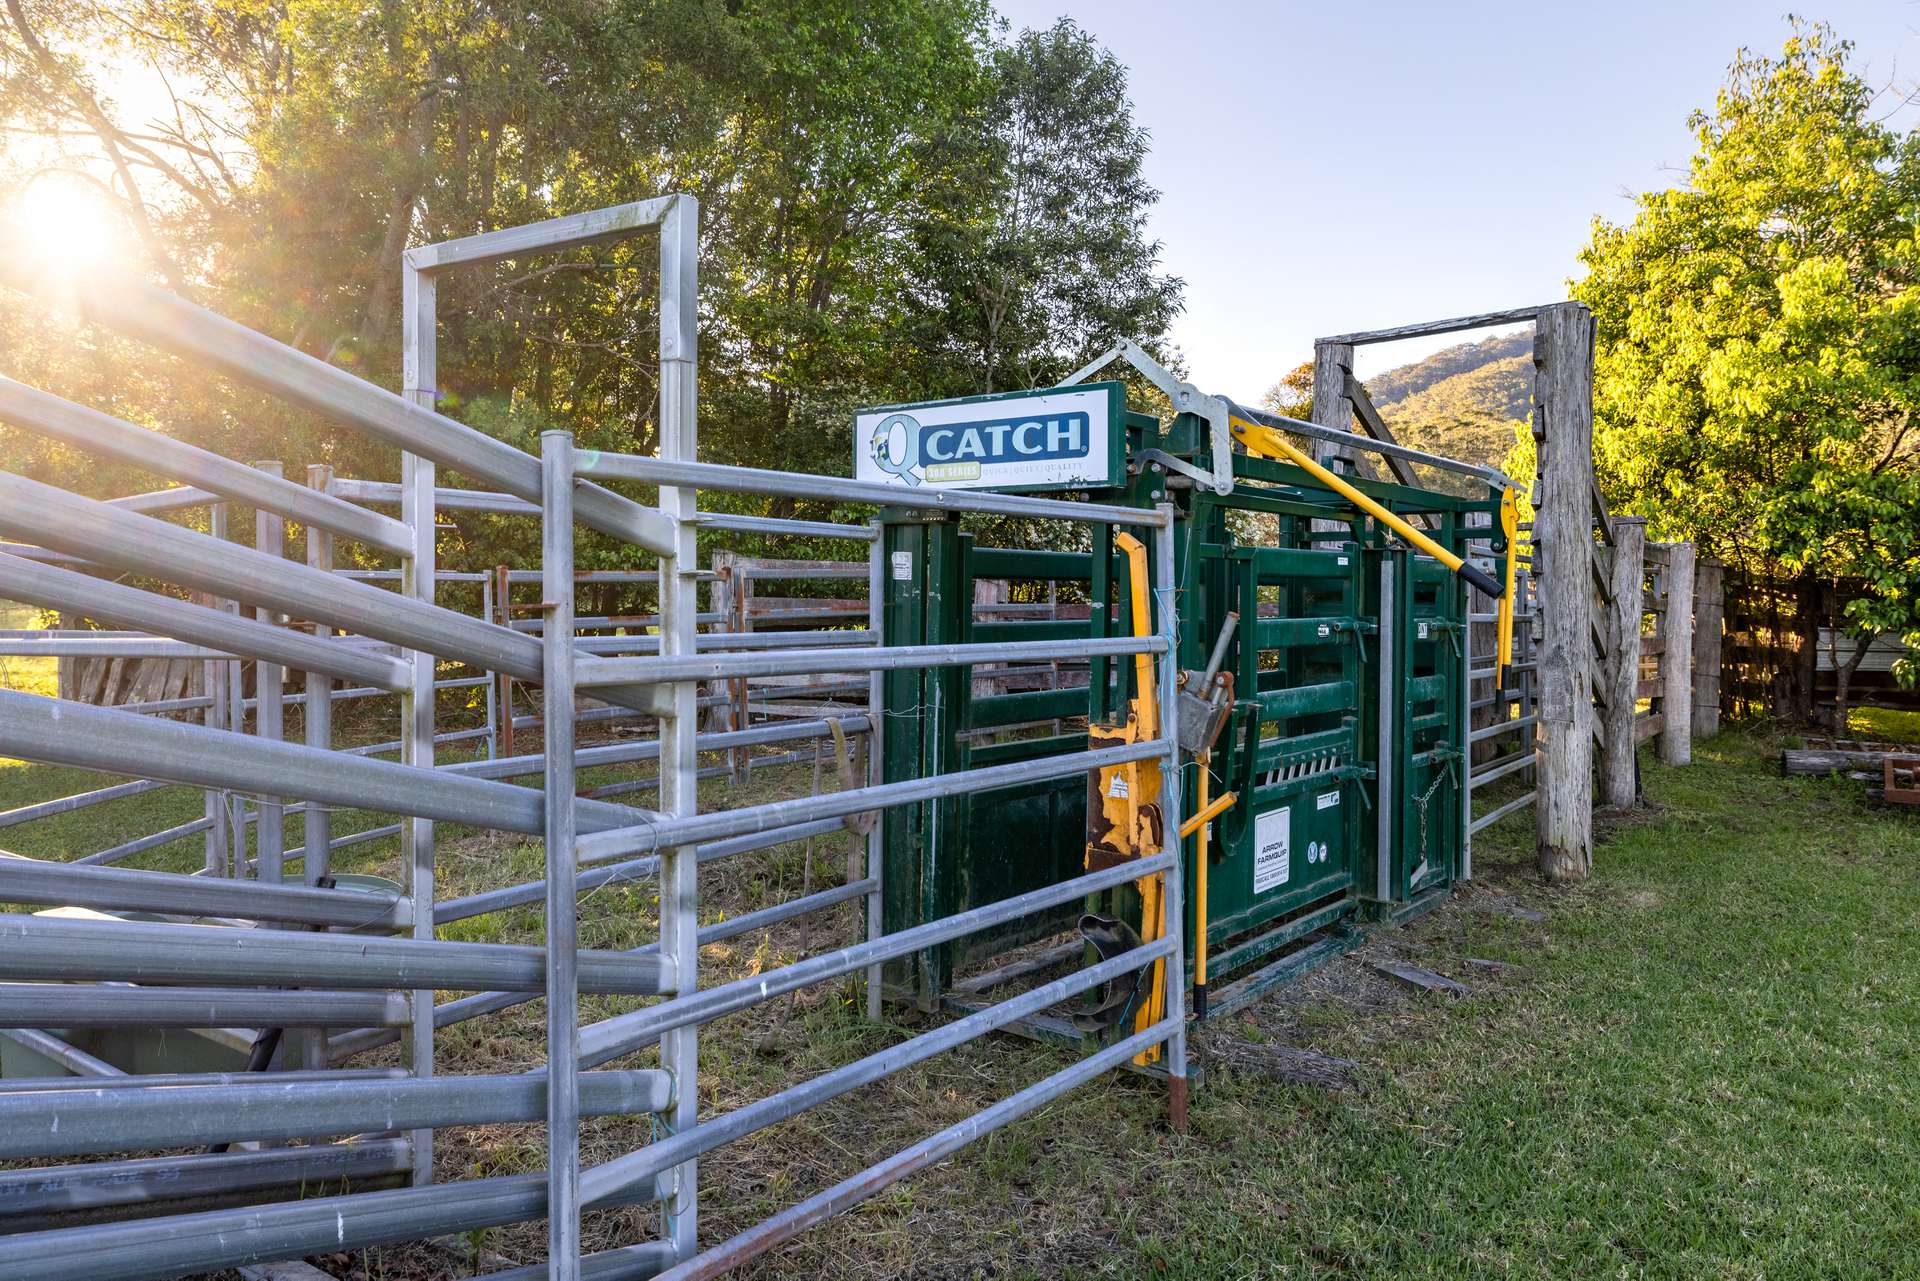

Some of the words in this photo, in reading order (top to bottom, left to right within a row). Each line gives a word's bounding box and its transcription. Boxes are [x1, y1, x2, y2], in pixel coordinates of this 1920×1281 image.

[872, 414, 922, 487] Q
[926, 418, 1081, 461] CATCH
[1262, 840, 1284, 854] ARROW
